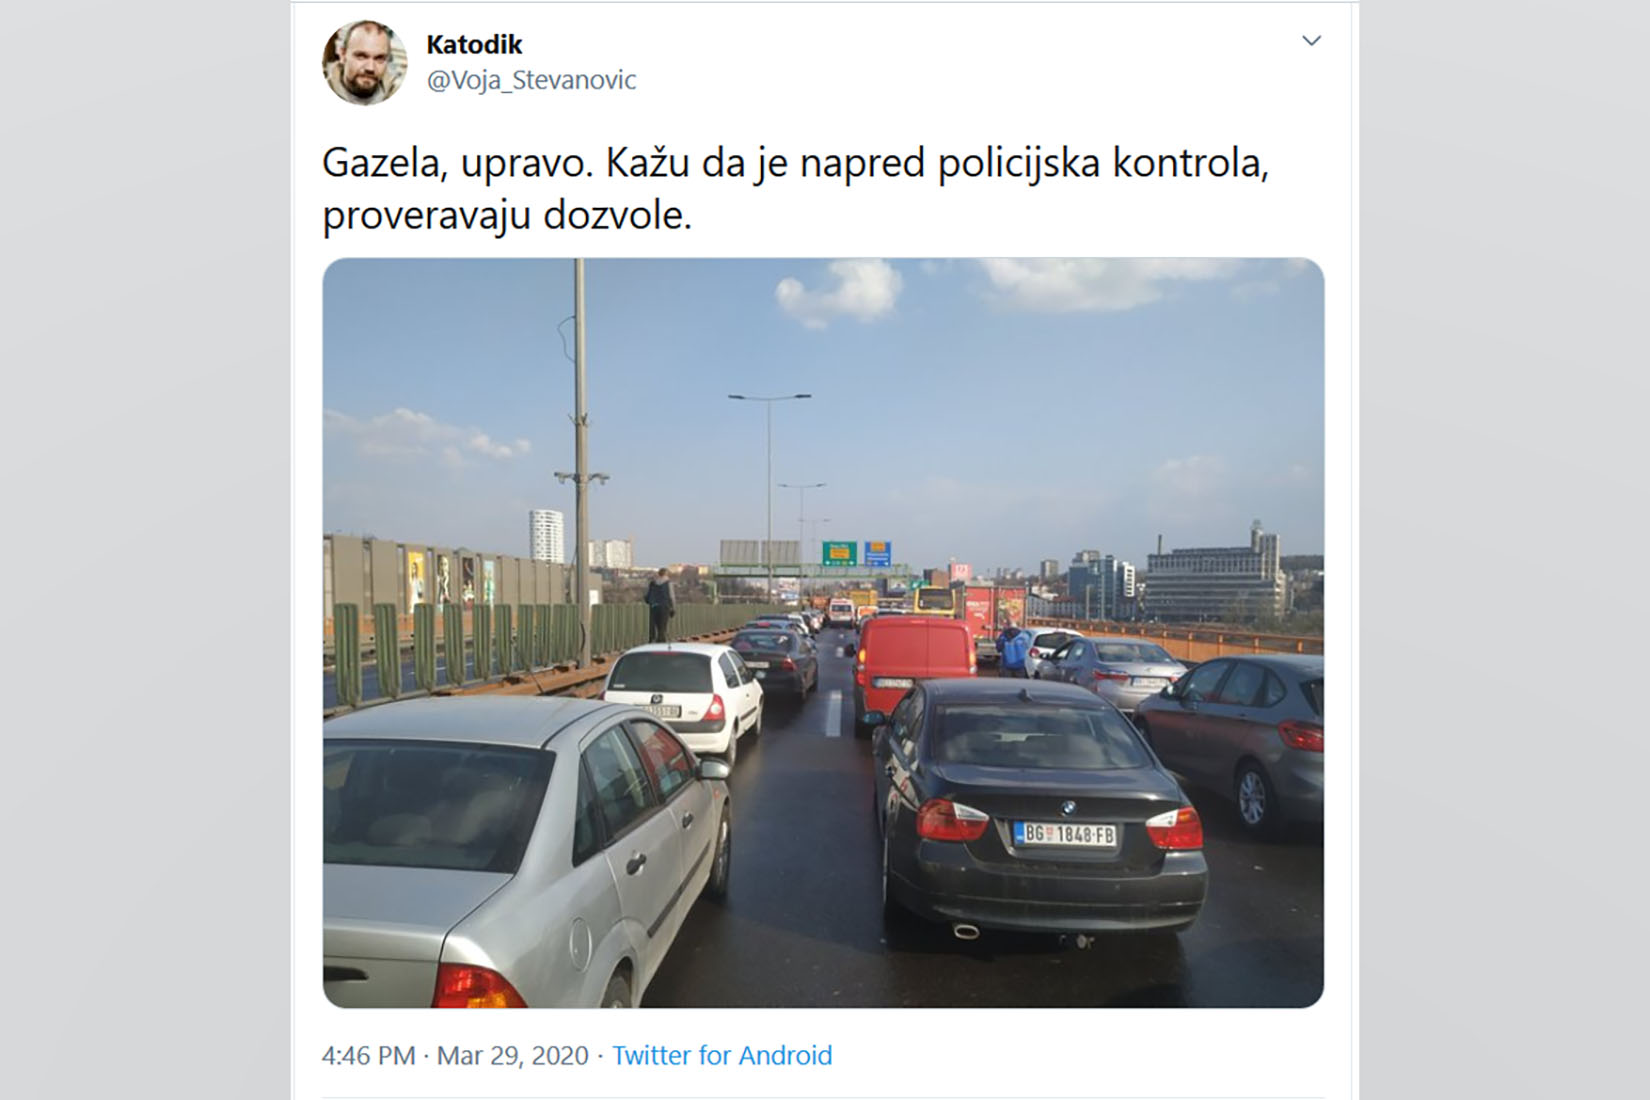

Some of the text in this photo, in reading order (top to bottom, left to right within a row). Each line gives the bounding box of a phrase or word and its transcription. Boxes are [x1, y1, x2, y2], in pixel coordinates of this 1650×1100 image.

[427, 33, 523, 55] Katodik
[427, 68, 637, 96] @Voja_Stevanovic
[322, 144, 1269, 188] Gazela, upravo. Kažu da je napred policijska kontrola,
[323, 196, 692, 240] proveravaju dozvole.
[1026, 824, 1044, 841] BG
[321, 1044, 832, 1070] 4:46 PM Mar 29, 2020 Twitter for Android
